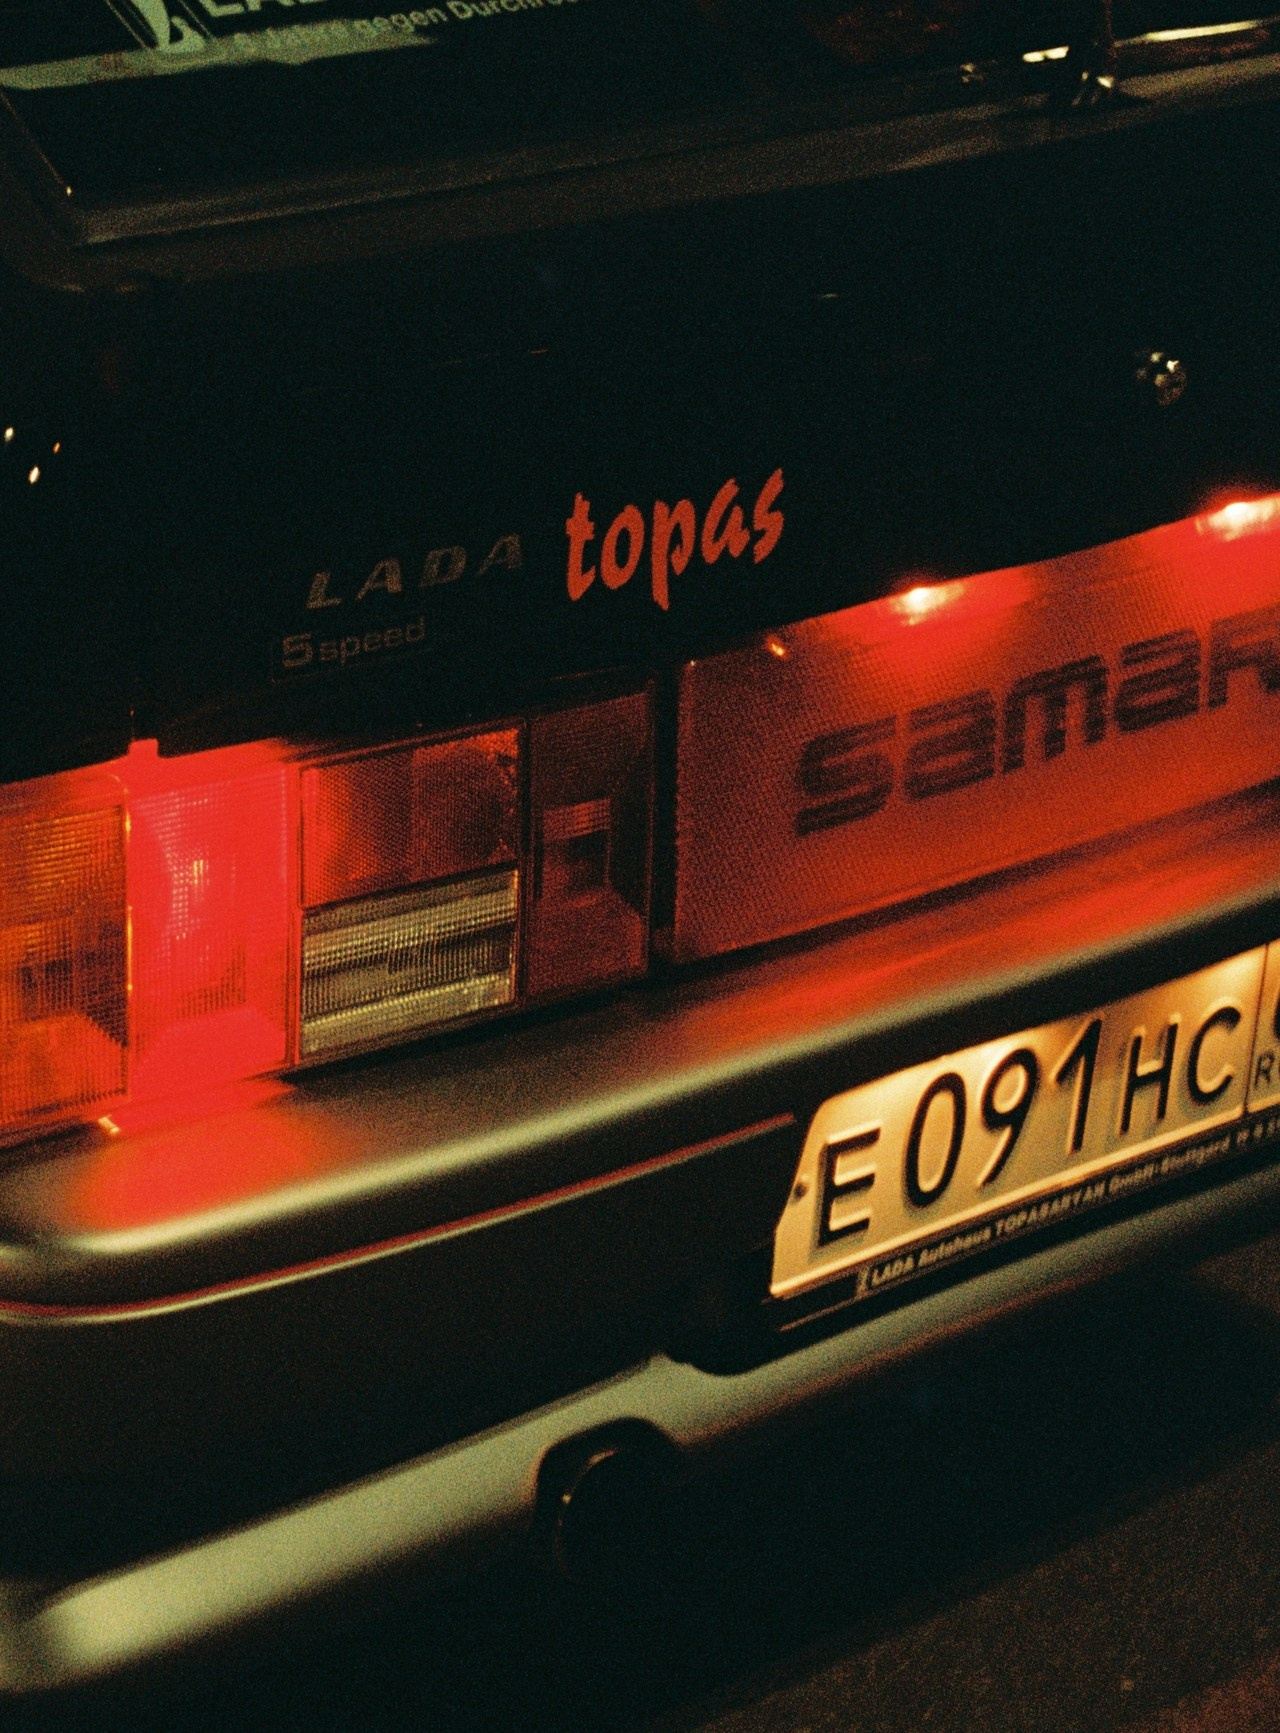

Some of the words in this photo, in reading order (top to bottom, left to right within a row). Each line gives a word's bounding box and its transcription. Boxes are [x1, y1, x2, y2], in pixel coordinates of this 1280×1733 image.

[353, 7, 448, 38] gegen
[565, 466, 785, 612] topas
[305, 533, 524, 610] LADA
[870, 1254, 914, 1285] LADA
